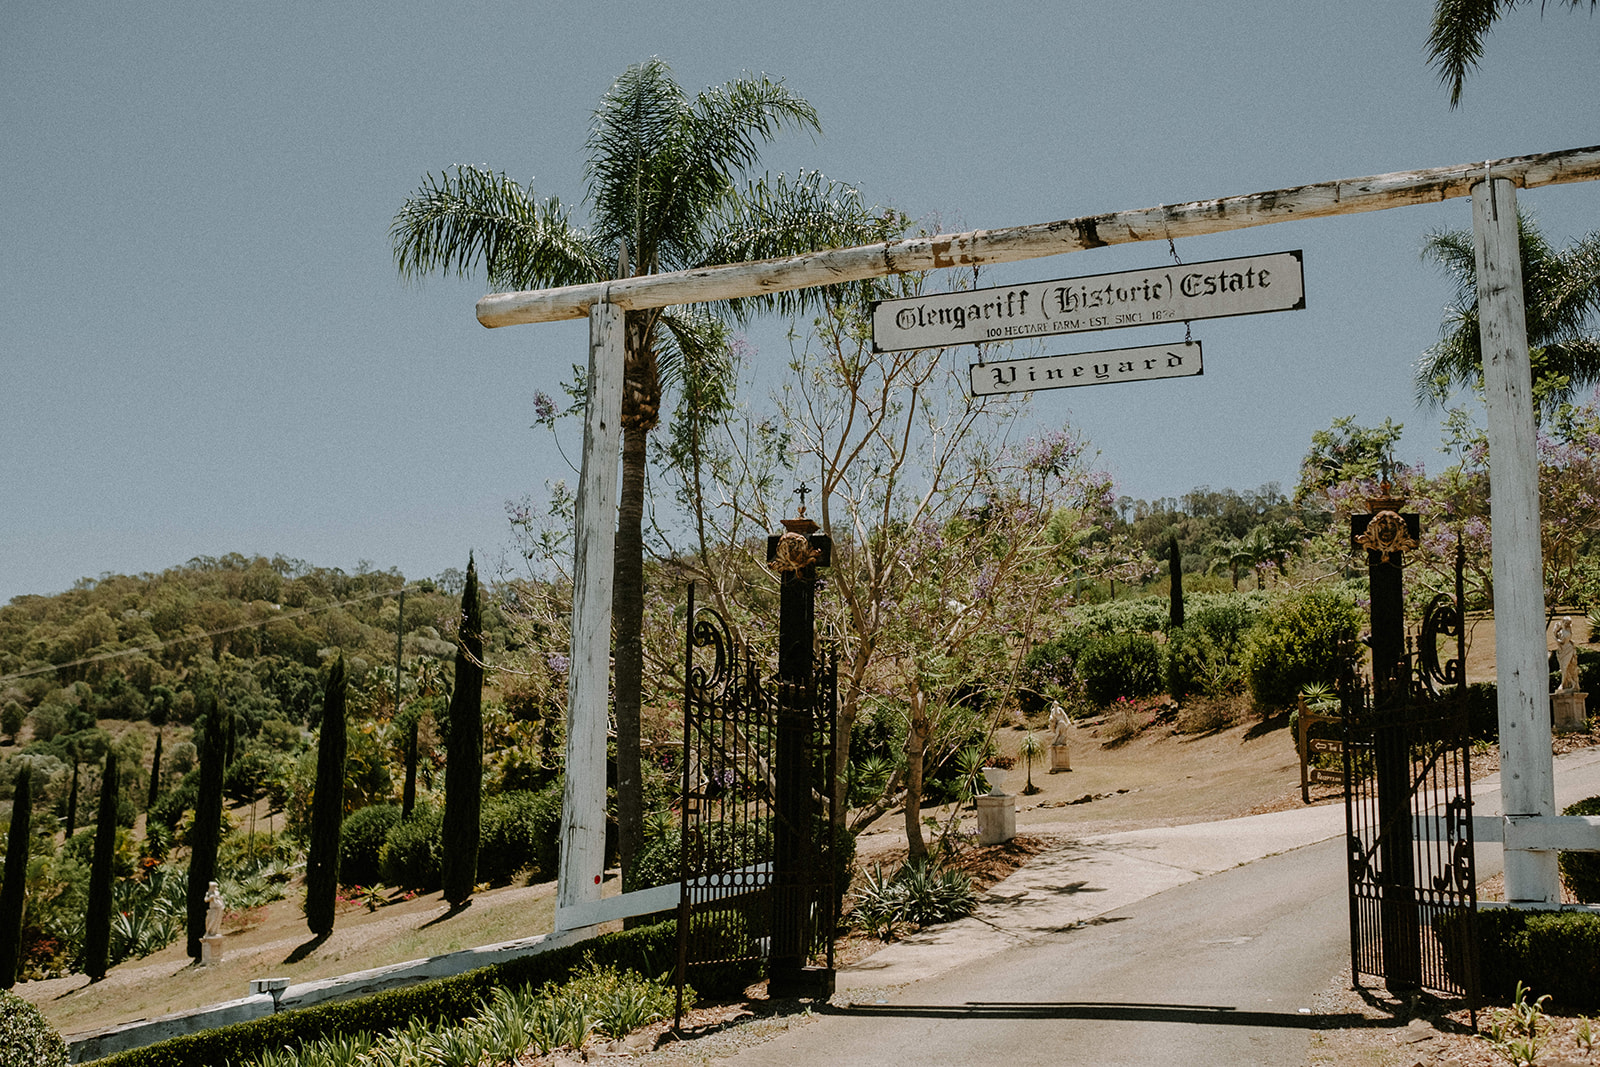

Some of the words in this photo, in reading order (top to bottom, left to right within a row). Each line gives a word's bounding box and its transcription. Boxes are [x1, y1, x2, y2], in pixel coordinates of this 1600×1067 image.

[896, 289, 1030, 331] Glengariff
[1041, 274, 1173, 320] (Historic)
[1180, 266, 1272, 298] Estate
[986, 328, 1002, 338] 100
[1004, 321, 1048, 336] HECTARE
[1053, 318, 1080, 331] FARM
[991, 351, 1184, 390] Vineyard
